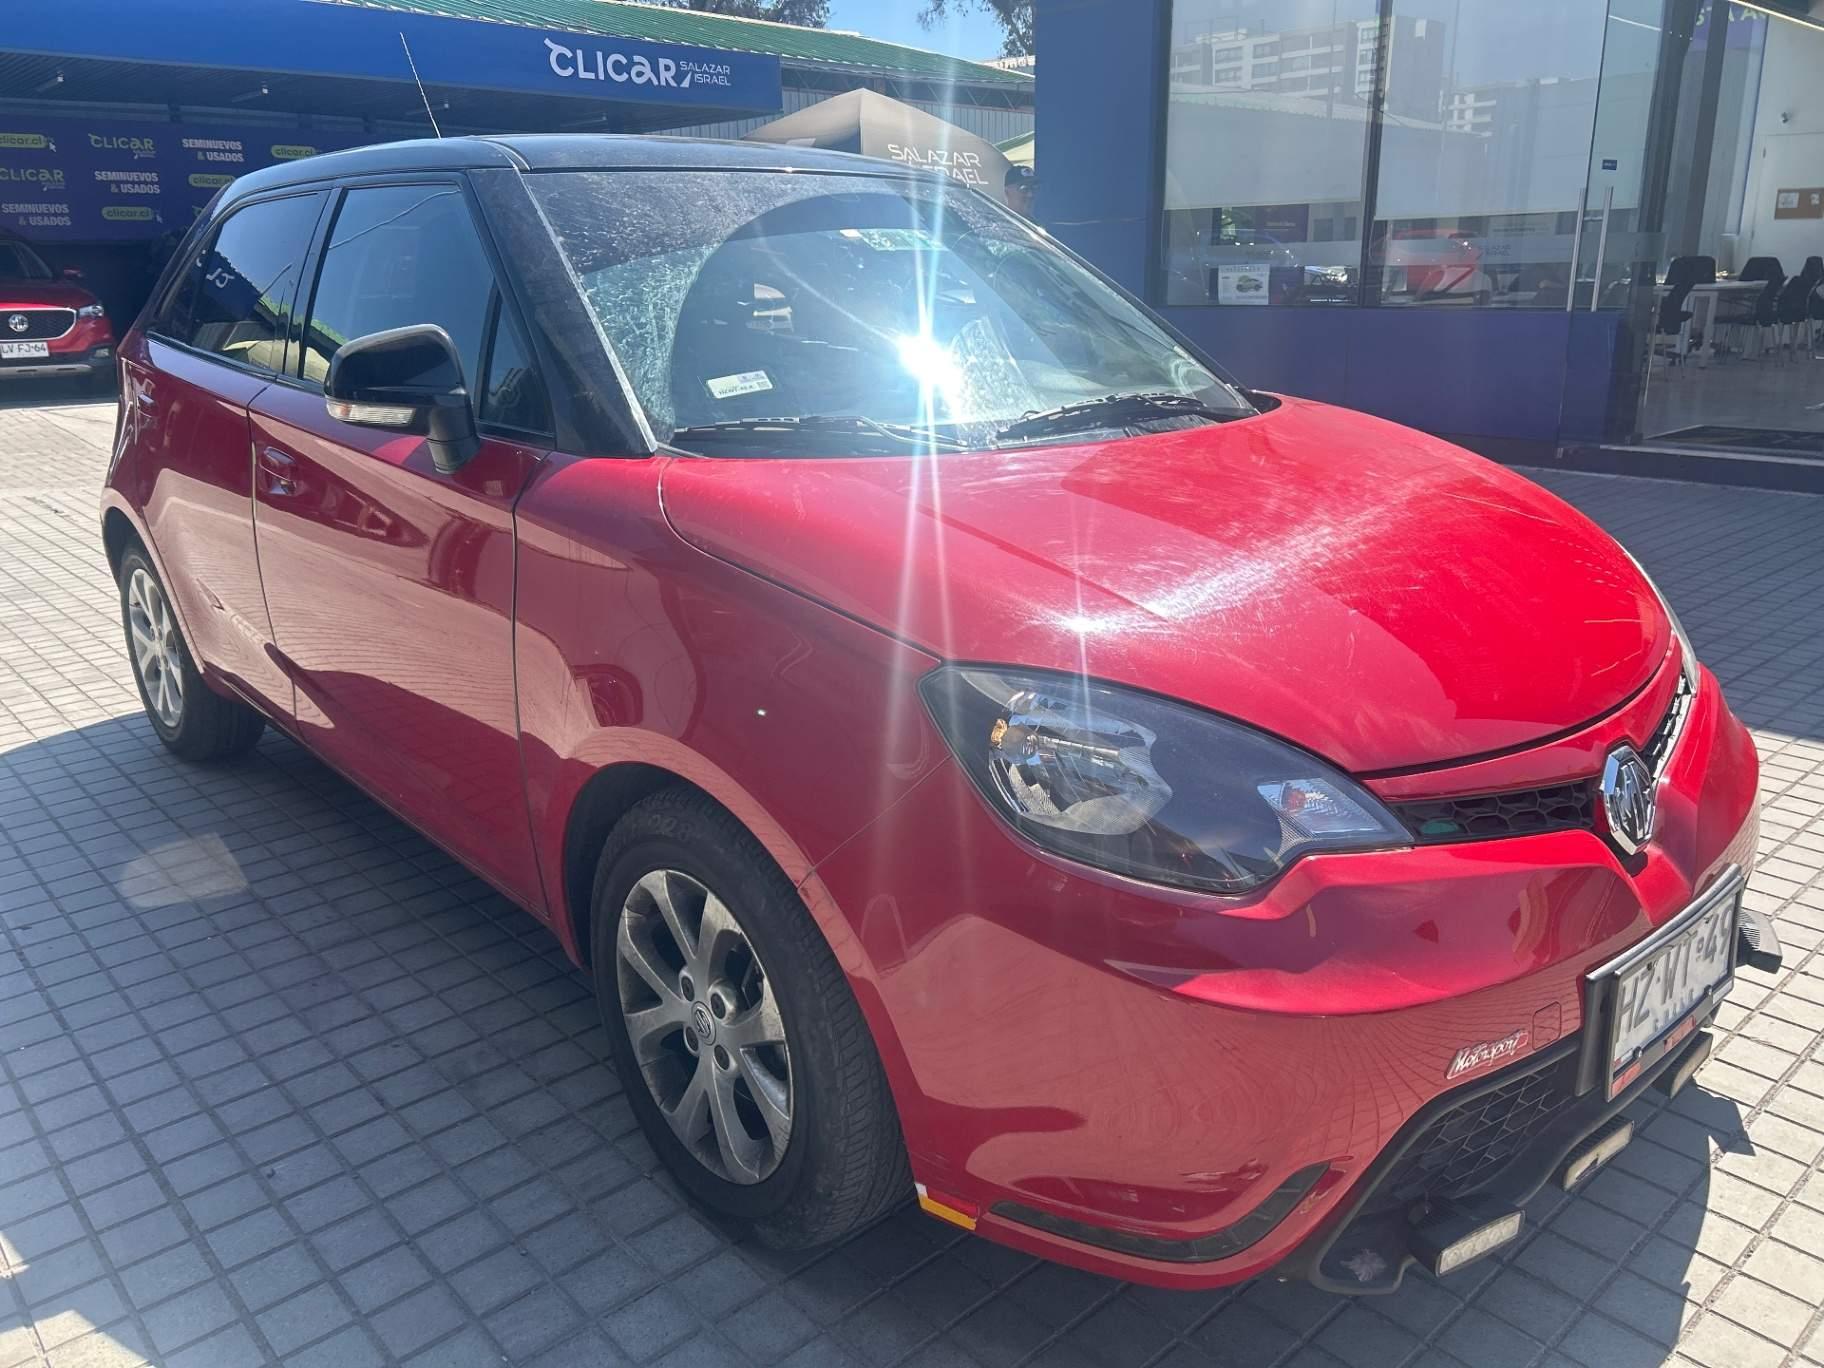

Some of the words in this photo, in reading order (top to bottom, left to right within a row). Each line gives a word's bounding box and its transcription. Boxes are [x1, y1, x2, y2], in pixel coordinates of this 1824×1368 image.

[680, 61, 731, 75] SALAZAR
[694, 73, 732, 86] ISRAEL
[182, 138, 243, 151] SEMINUEVOS
[206, 151, 245, 163] USADOS
[887, 143, 982, 168] SALAZAR
[94, 170, 159, 183] SEMINUEVOS
[120, 183, 161, 195] USADOS
[1, 203, 70, 215] SEMINUEVOS
[105, 207, 150, 219] clicar.cl
[28, 215, 72, 227] USADOS
